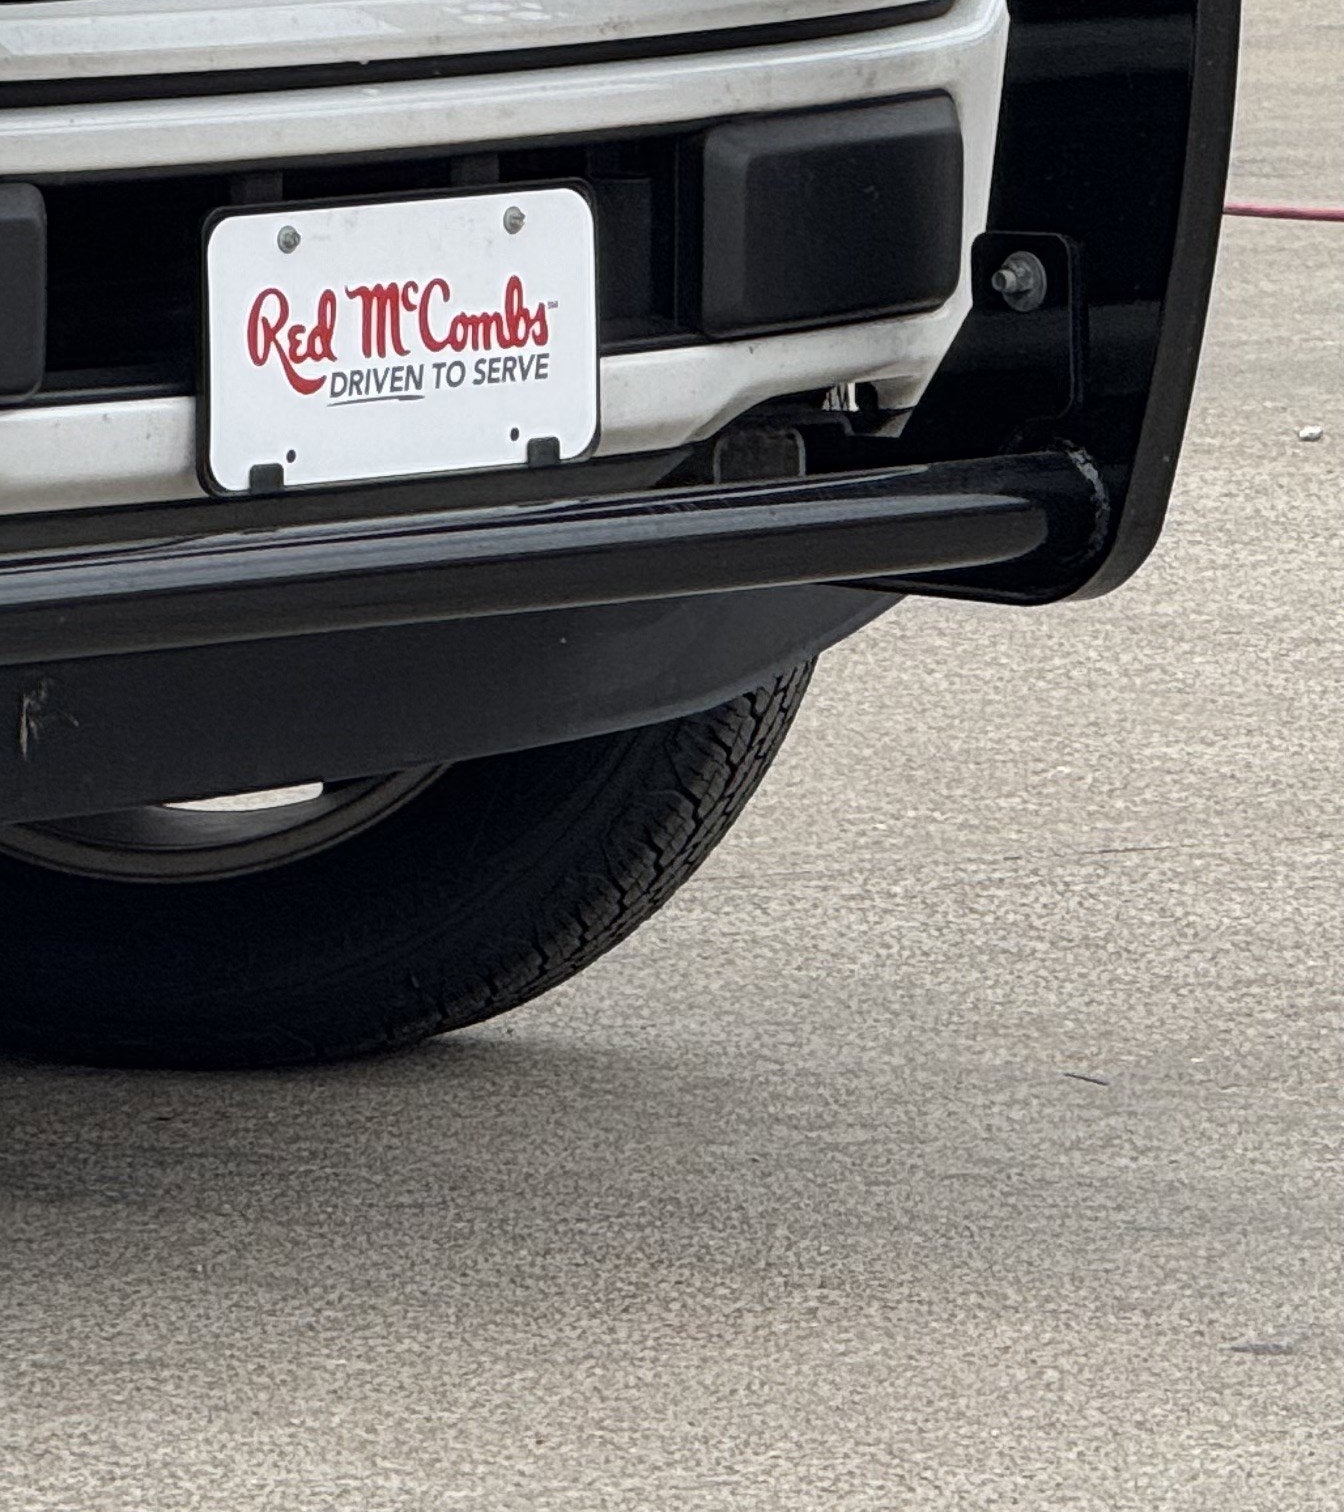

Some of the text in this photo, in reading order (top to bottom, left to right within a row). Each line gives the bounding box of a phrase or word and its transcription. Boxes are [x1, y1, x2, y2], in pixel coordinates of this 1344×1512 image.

[247, 275, 549, 395] Red McCombs
[329, 352, 550, 399] DRIVEN TO SERVE
